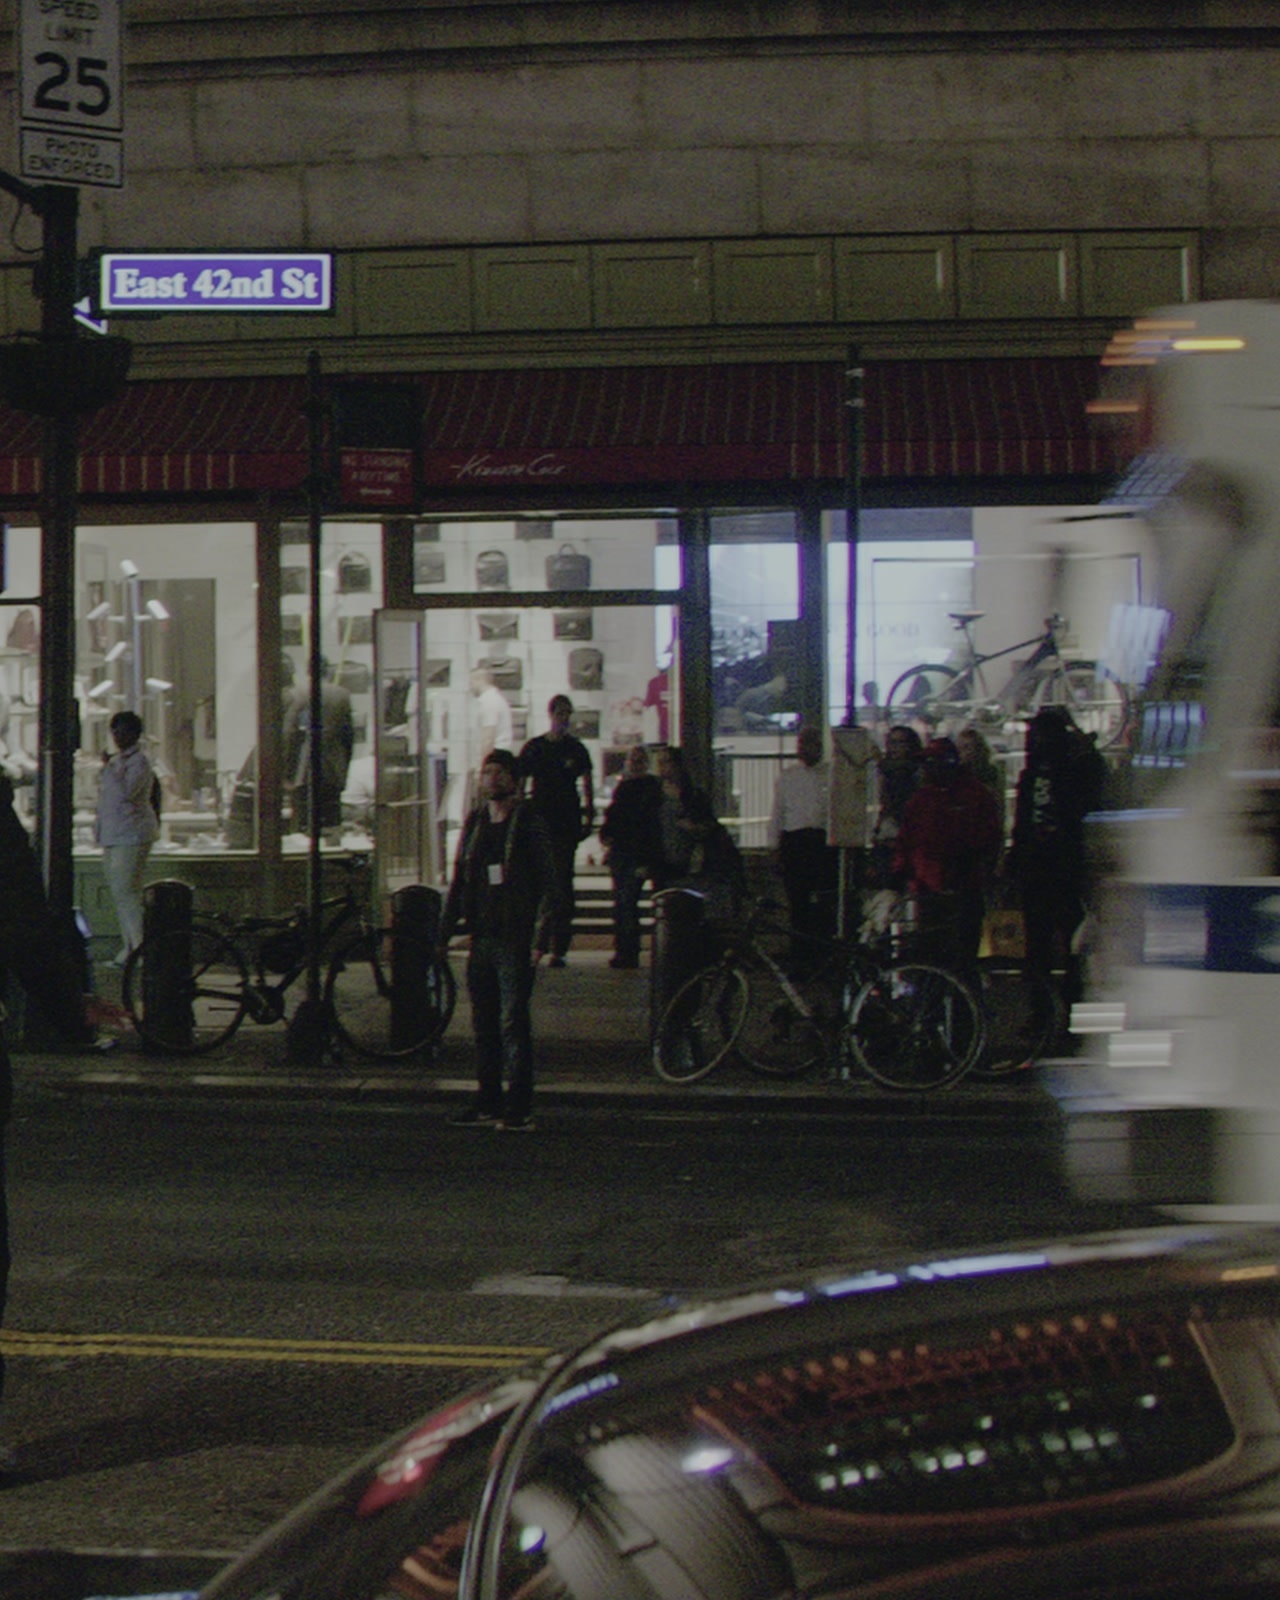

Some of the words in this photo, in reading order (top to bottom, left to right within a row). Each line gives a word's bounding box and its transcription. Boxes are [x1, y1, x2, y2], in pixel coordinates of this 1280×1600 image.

[40, 0, 99, 20] SPEED
[45, 22, 94, 44] LIMIT
[34, 51, 111, 116] 25
[45, 137, 100, 158] PHOTO
[28, 154, 116, 178] ENFORCED
[113, 268, 188, 298] East
[192, 269, 275, 299] 42nd
[281, 268, 320, 299] St
